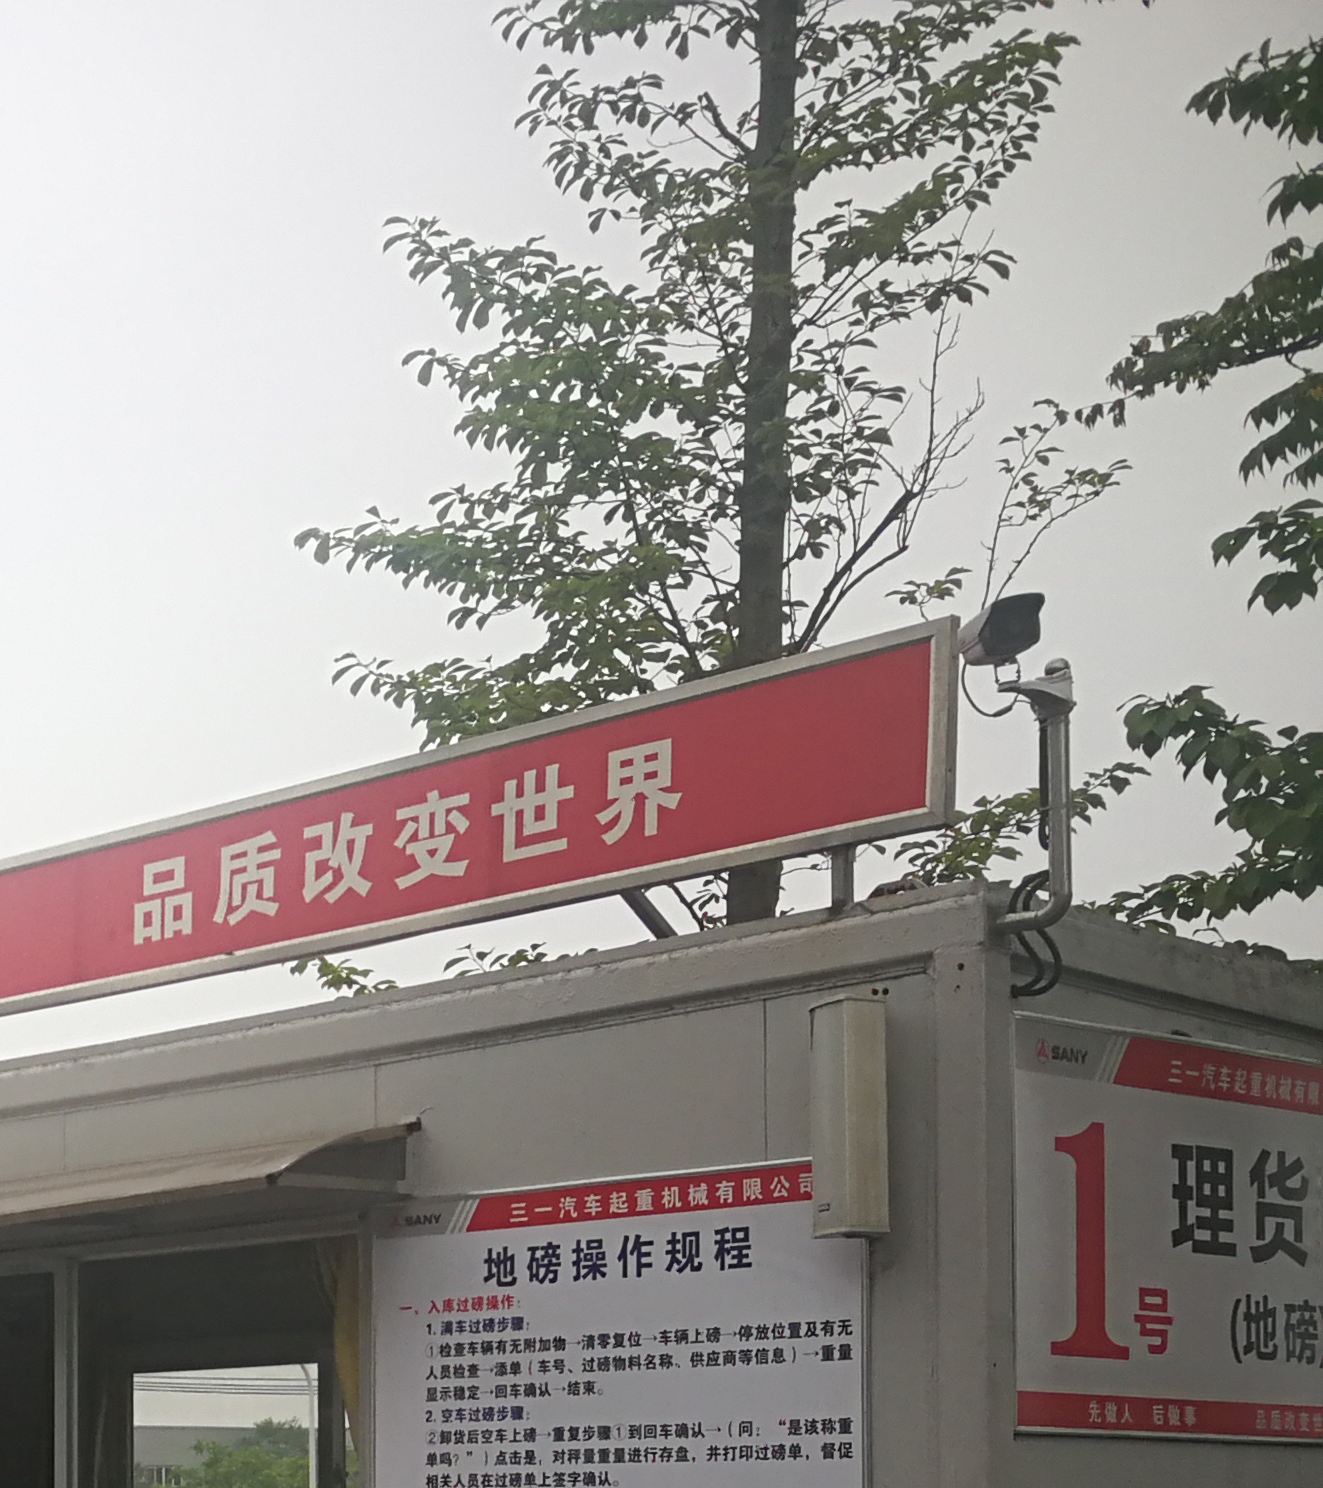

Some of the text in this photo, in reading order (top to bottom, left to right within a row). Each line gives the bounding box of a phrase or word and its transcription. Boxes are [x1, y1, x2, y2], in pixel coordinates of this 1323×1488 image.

[132, 737, 684, 946] 品质改变世界
[1051, 1045, 1088, 1065] SANY
[404, 1212, 443, 1227] SANY
[509, 1171, 814, 1224] 三一汽车起重机械有限公司
[1170, 1143, 1309, 1268] 理货
[482, 1225, 754, 1289] 地磅操作规程
[1088, 1400, 1134, 1424] 先做人
[1152, 1403, 1197, 1428] 后做事
